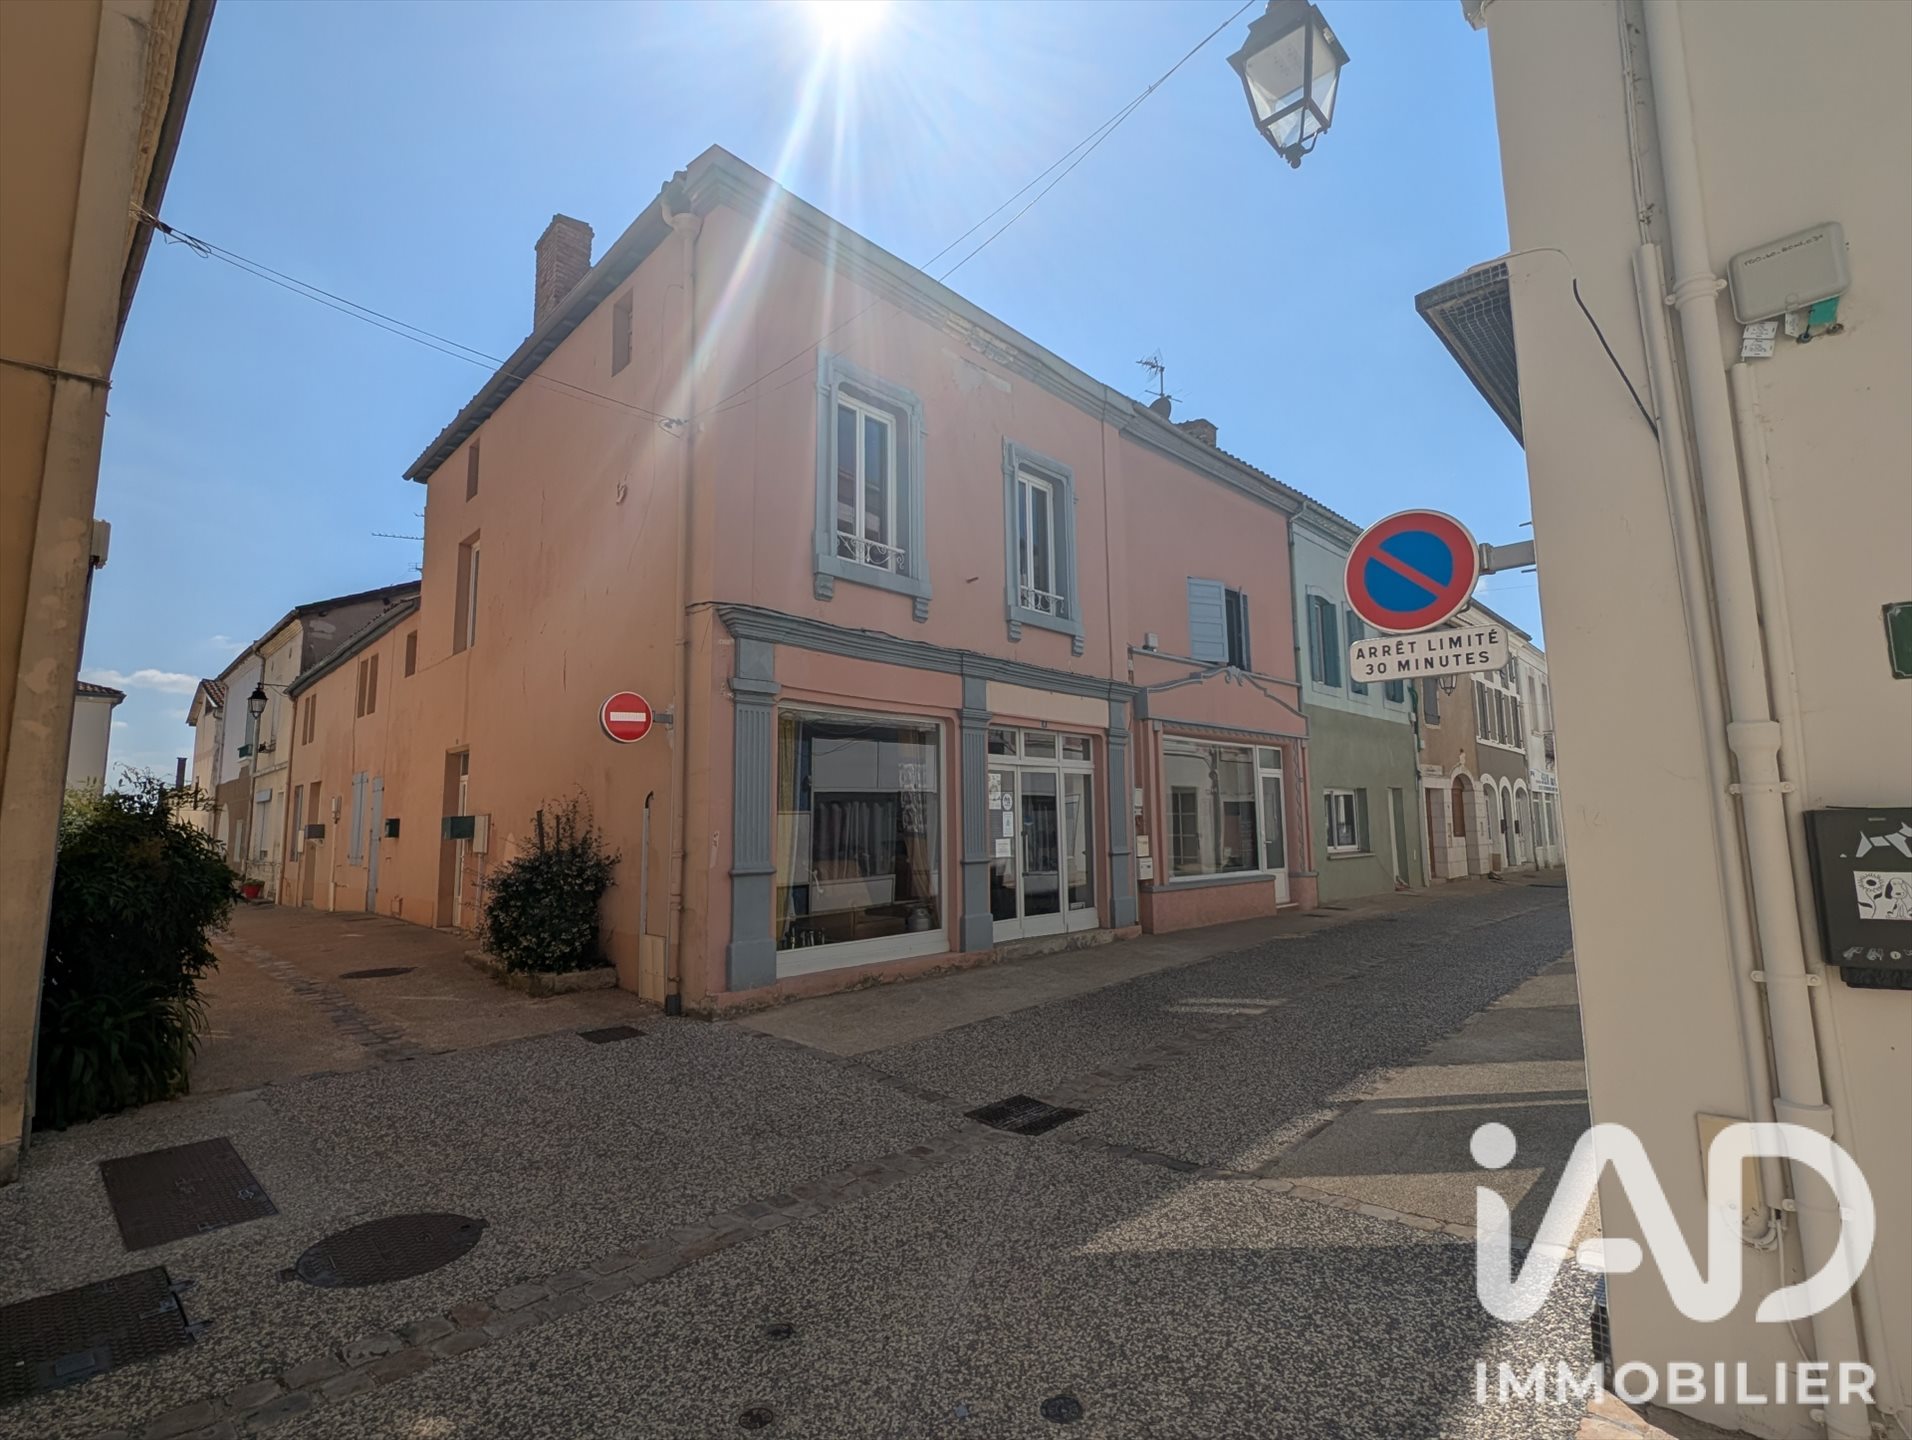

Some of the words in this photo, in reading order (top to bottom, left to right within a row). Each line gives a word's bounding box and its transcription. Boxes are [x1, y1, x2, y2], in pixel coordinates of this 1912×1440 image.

[1356, 640, 1417, 660] ARRÊT
[1428, 629, 1499, 652] LIMITÉ
[1365, 662, 1387, 676] 30
[1397, 651, 1490, 672] MINUTES
